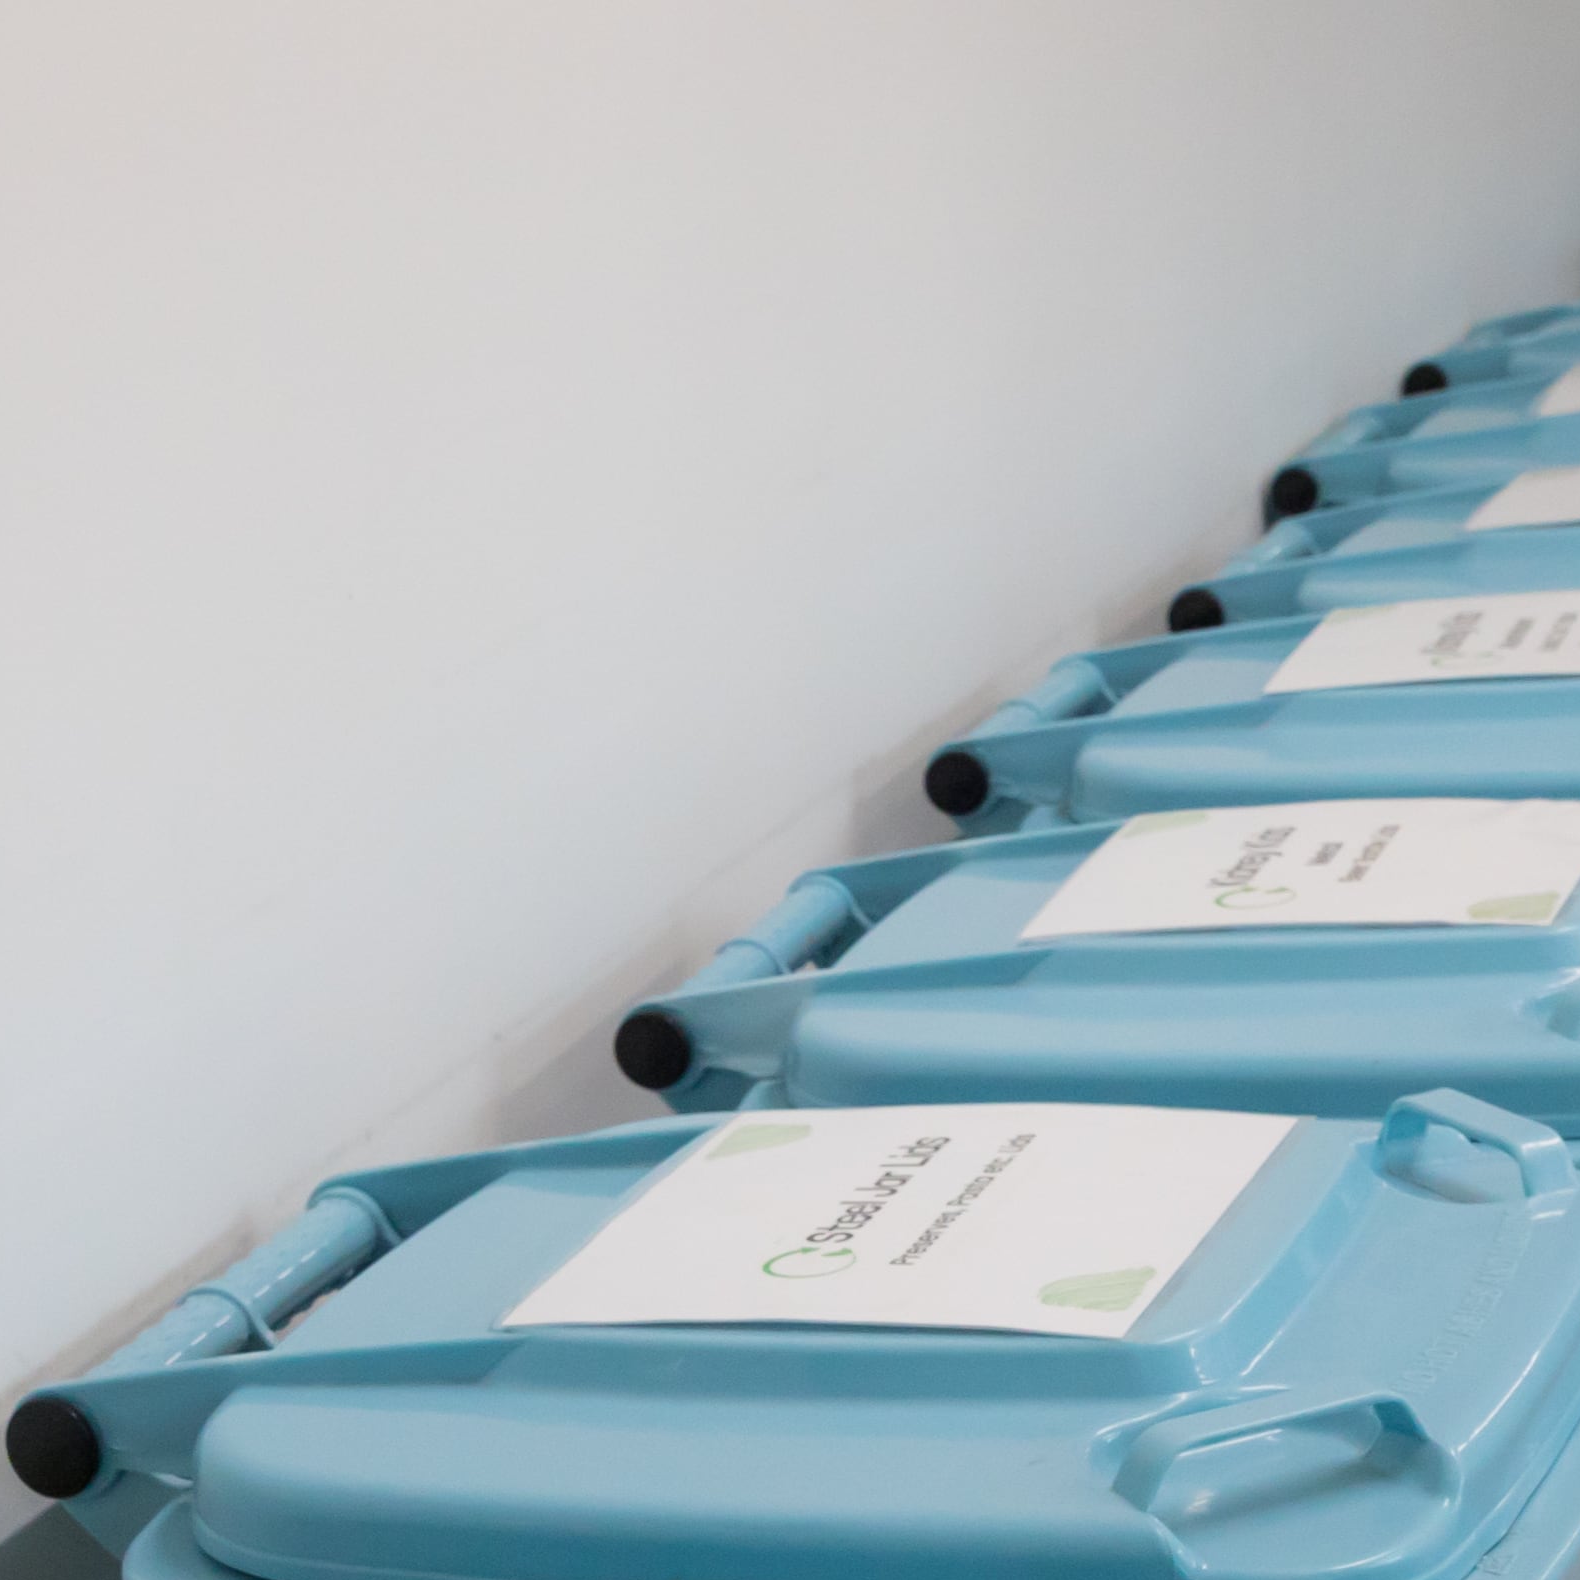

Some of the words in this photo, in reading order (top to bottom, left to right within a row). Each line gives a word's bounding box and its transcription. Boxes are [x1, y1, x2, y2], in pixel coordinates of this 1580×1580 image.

[879, 1136, 952, 1167] Lids
[854, 1171, 914, 1197] Jar
[806, 1200, 888, 1243] Steel
